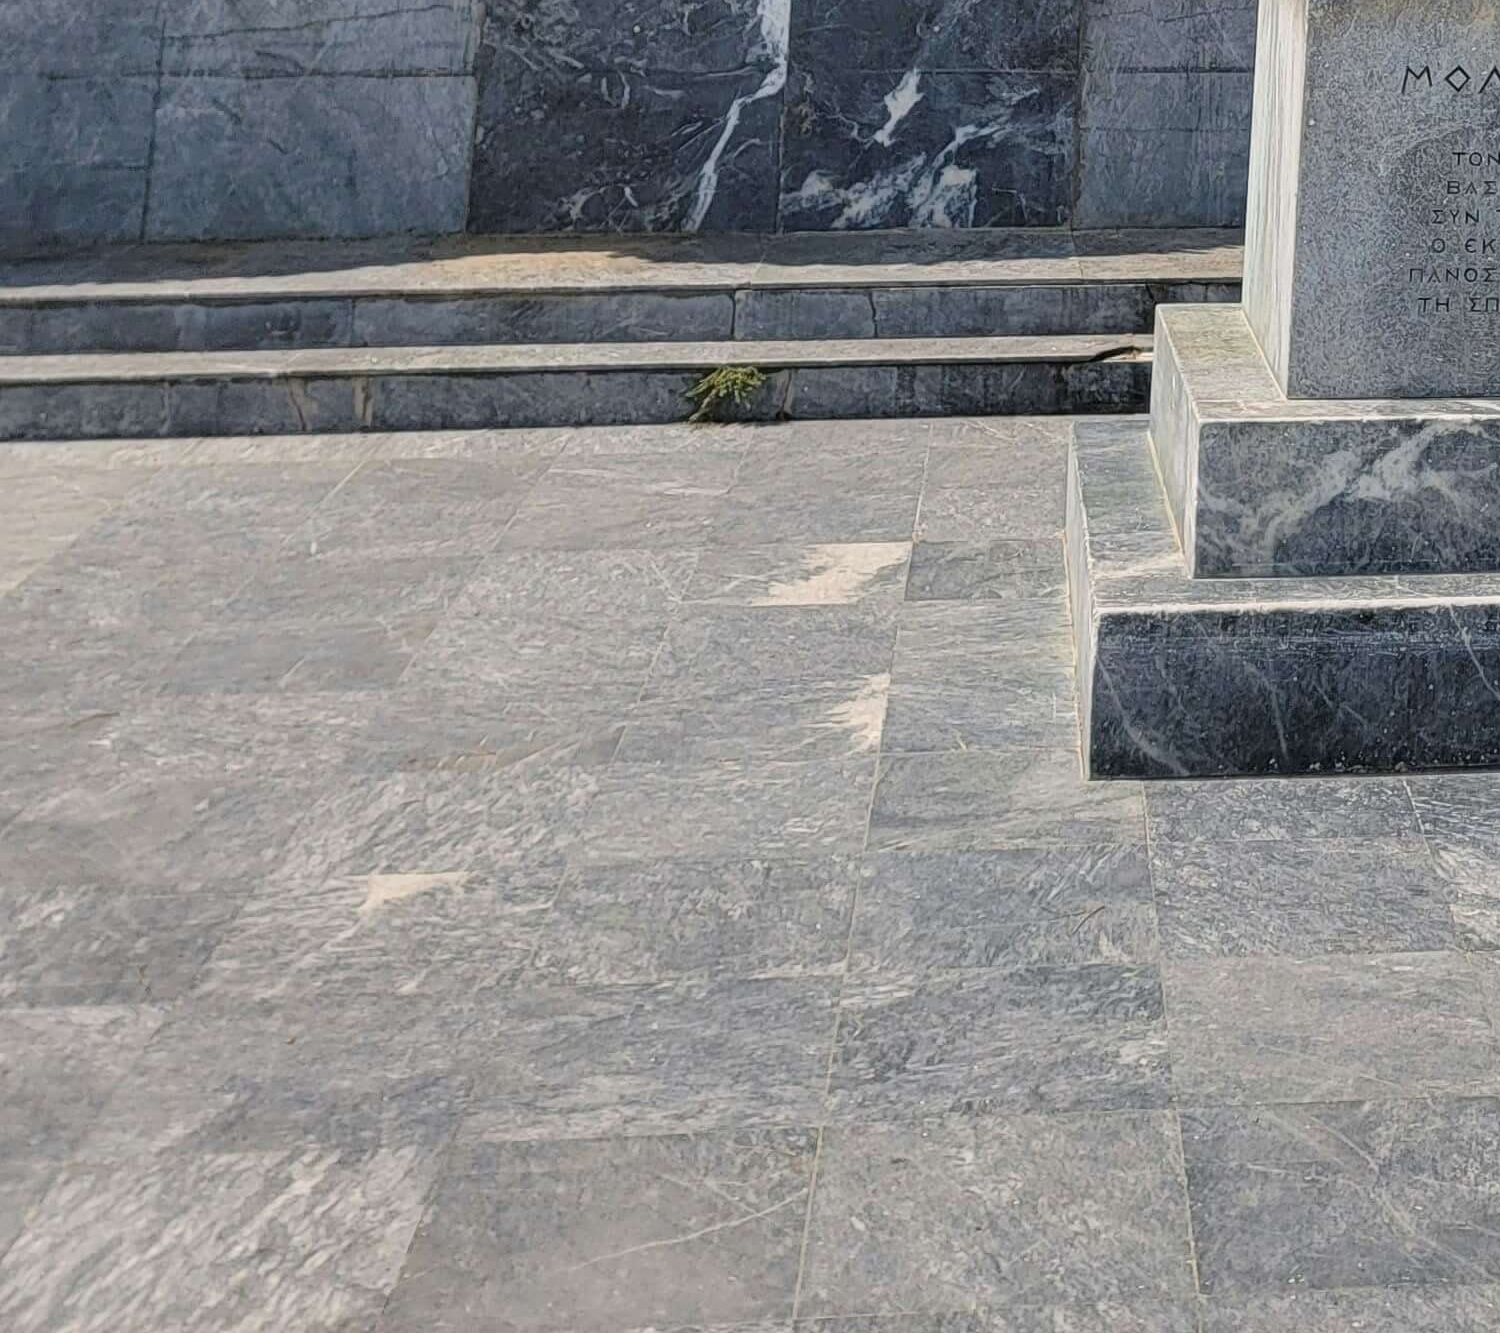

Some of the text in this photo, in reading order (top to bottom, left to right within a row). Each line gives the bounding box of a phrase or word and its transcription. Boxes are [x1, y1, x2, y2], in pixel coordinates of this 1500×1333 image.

[1431, 209, 1480, 224] ΣΥΝ
[1431, 238, 1446, 254] Ο
[1464, 238, 1497, 254] ΕΚ
[1409, 267, 1498, 283] ΠΑΝΟΣ
[1418, 297, 1450, 313] ΤΗ
